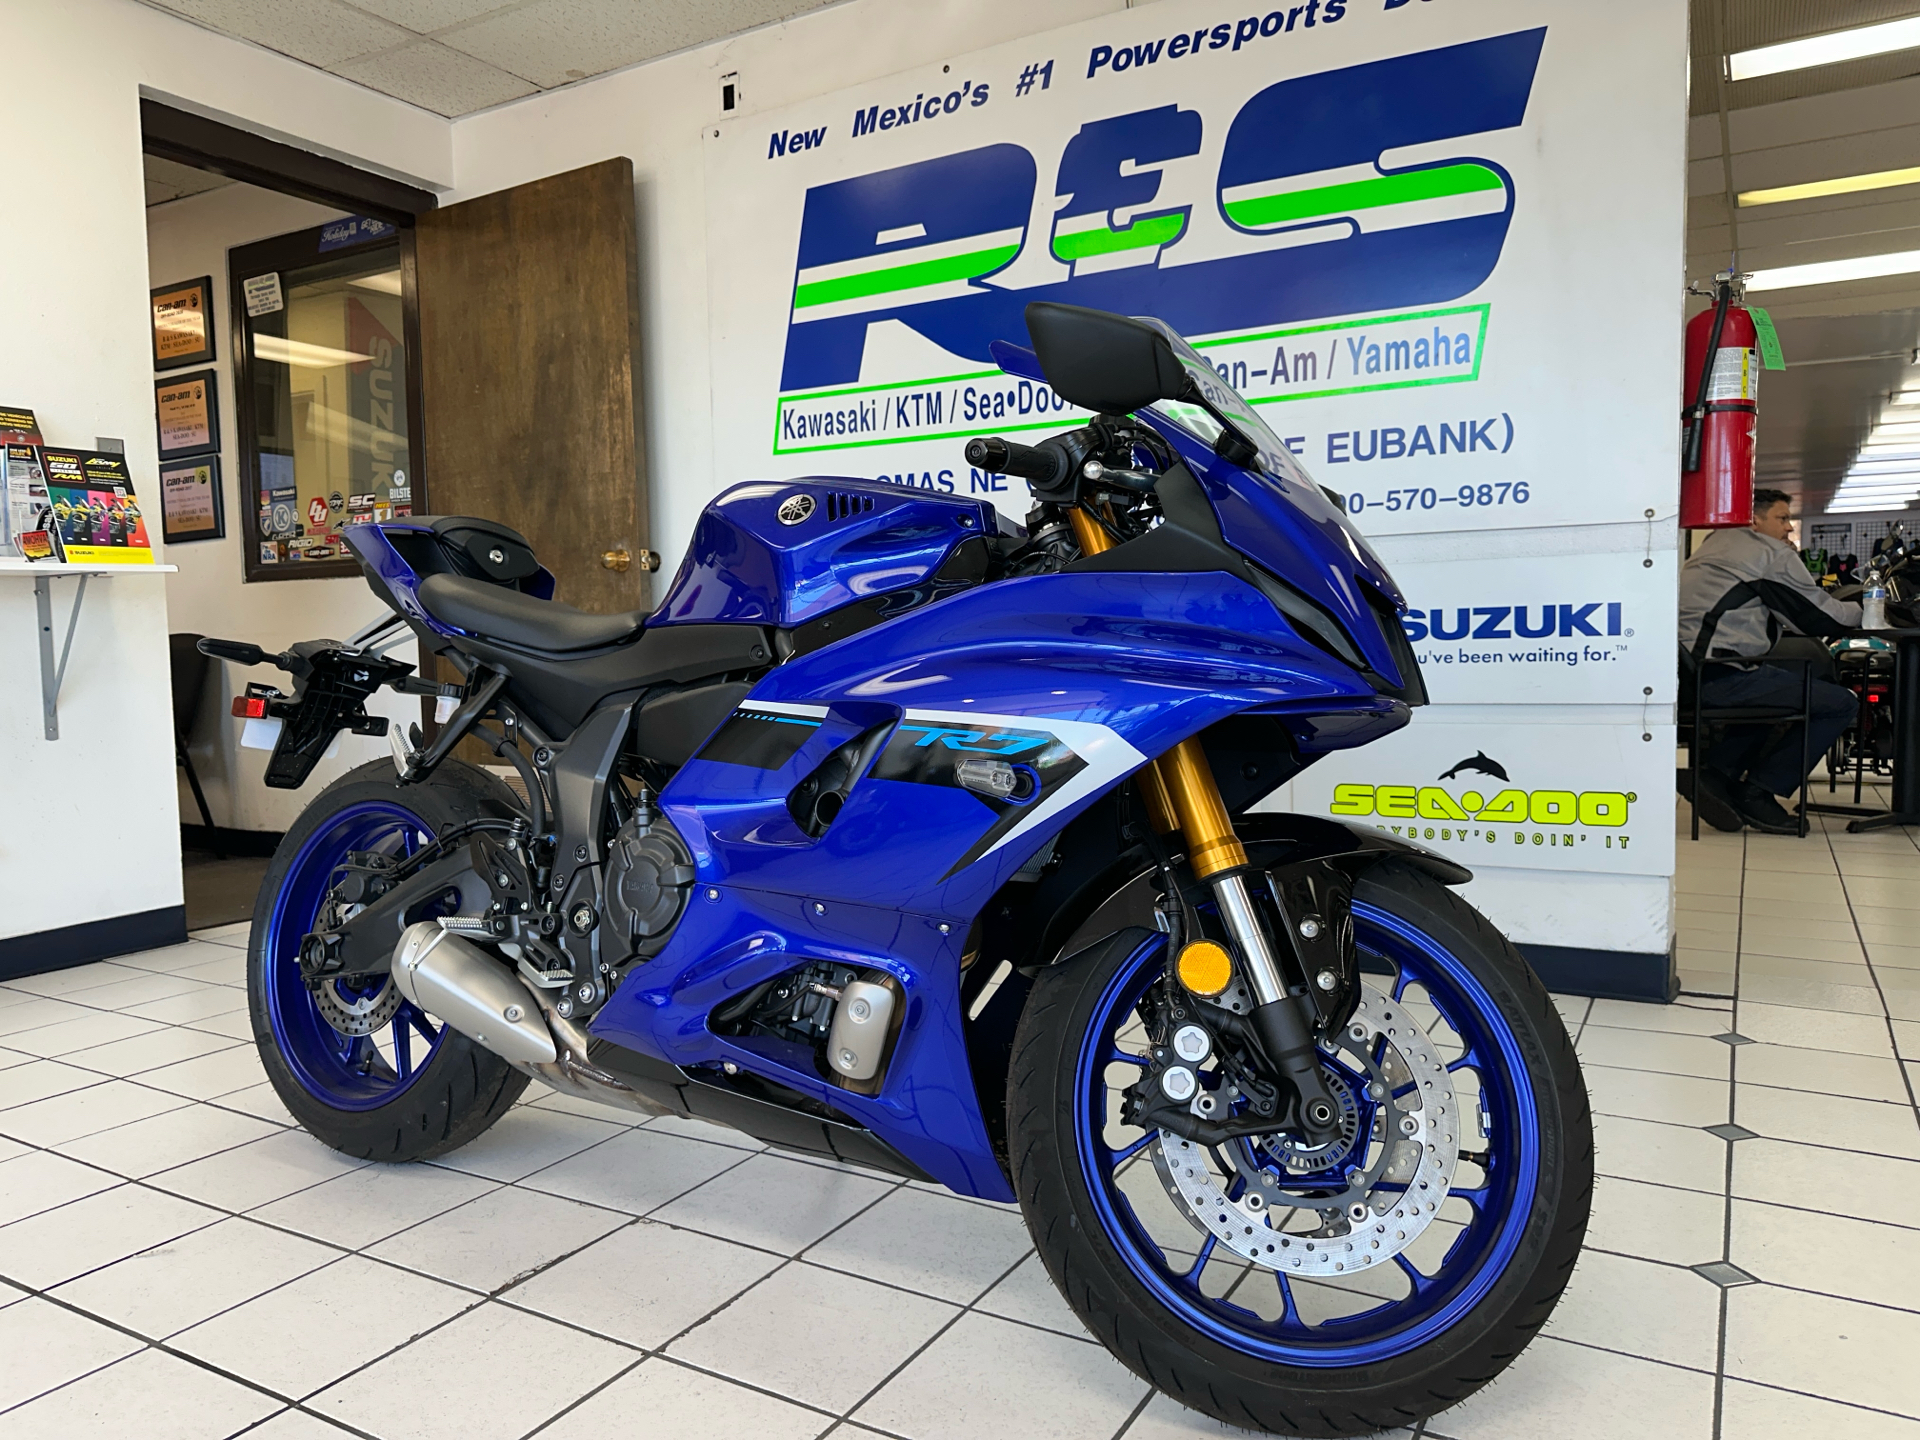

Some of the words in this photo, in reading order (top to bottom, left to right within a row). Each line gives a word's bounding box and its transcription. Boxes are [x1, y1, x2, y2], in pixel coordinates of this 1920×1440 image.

[768, 126, 827, 159] New
[852, 80, 990, 138] Mexico's
[1016, 60, 1054, 97] #1
[1086, 0, 1346, 79] Powersports
[783, 398, 877, 440] Kawasaki
[896, 391, 942, 429] KTM
[1202, 346, 1317, 389] an-Am
[1346, 326, 1471, 376] Yamaha
[47, 455, 77, 463] SUZUKI
[970, 468, 1008, 494] NE
[1326, 412, 1514, 464] EUBANK)
[272, 488, 295, 497] Kawasaki
[1458, 648, 1503, 664] been
[1508, 647, 1578, 666] waiting
[1514, 831, 1586, 847] DOIN'
[1605, 836, 1629, 849] IT
